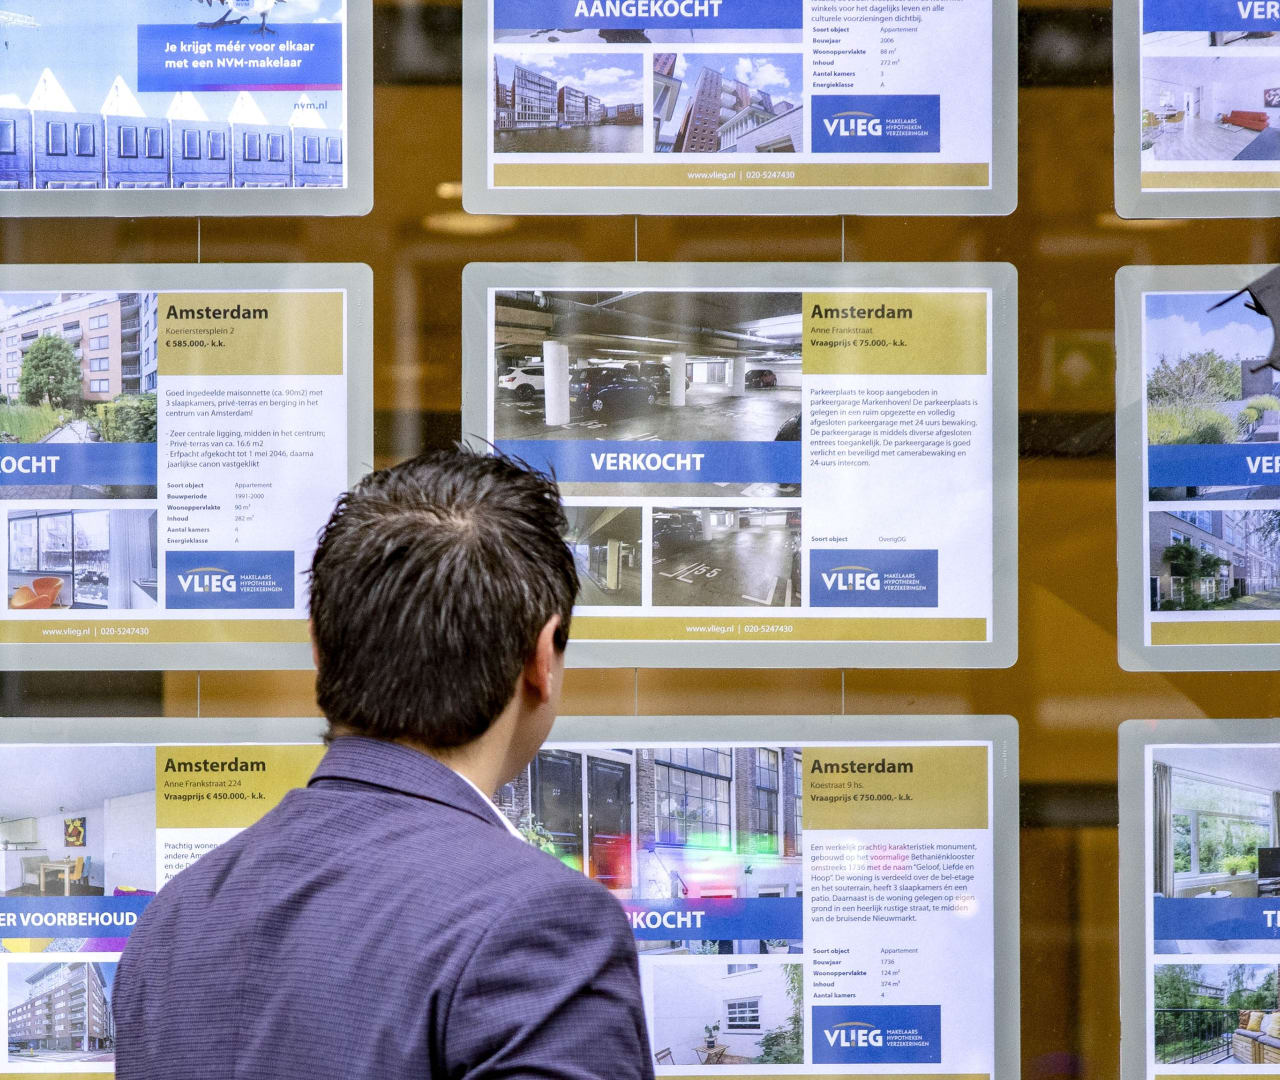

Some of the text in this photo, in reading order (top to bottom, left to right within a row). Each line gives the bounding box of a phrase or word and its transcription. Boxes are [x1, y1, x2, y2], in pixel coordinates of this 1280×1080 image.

[574, 0, 722, 17] AANGEKOCHT
[180, 41, 212, 54] krijgt
[215, 40, 246, 52] méér
[248, 43, 276, 52] voor
[279, 40, 315, 52] elkaar
[165, 56, 302, 68] met een NVM-makelaar
[293, 100, 327, 110] nvm.nl
[823, 119, 882, 136] VLIEG
[166, 304, 268, 319] Amsterdam
[811, 304, 912, 319] Amsterdam
[166, 327, 228, 336] Koerierstersplein
[810, 326, 873, 334] Anne Frankstraat
[173, 340, 209, 348] 585.000,-
[810, 339, 851, 348] Vraagprijs
[860, 339, 891, 347] 75.000,-
[210, 409, 253, 417] Amsterdam!
[591, 453, 705, 471] VERKOCHT
[178, 575, 236, 592] VLIEG
[821, 573, 880, 590] VLIEG
[42, 627, 149, 637] www.vlieg.nl 020-5247430
[686, 625, 793, 634] www.vlieg.nl 020-5247430
[164, 757, 266, 772] Amsterdam
[810, 758, 913, 774] Amsterdam
[164, 780, 184, 788] Anne
[853, 781, 863, 789] hs.
[164, 793, 205, 802] Vraagprijs
[213, 792, 250, 800] 450.000,-
[810, 794, 852, 803] Vraagprijs
[20, 912, 137, 926] VOORBEHOUD
[824, 1029, 883, 1047] VLIEG
